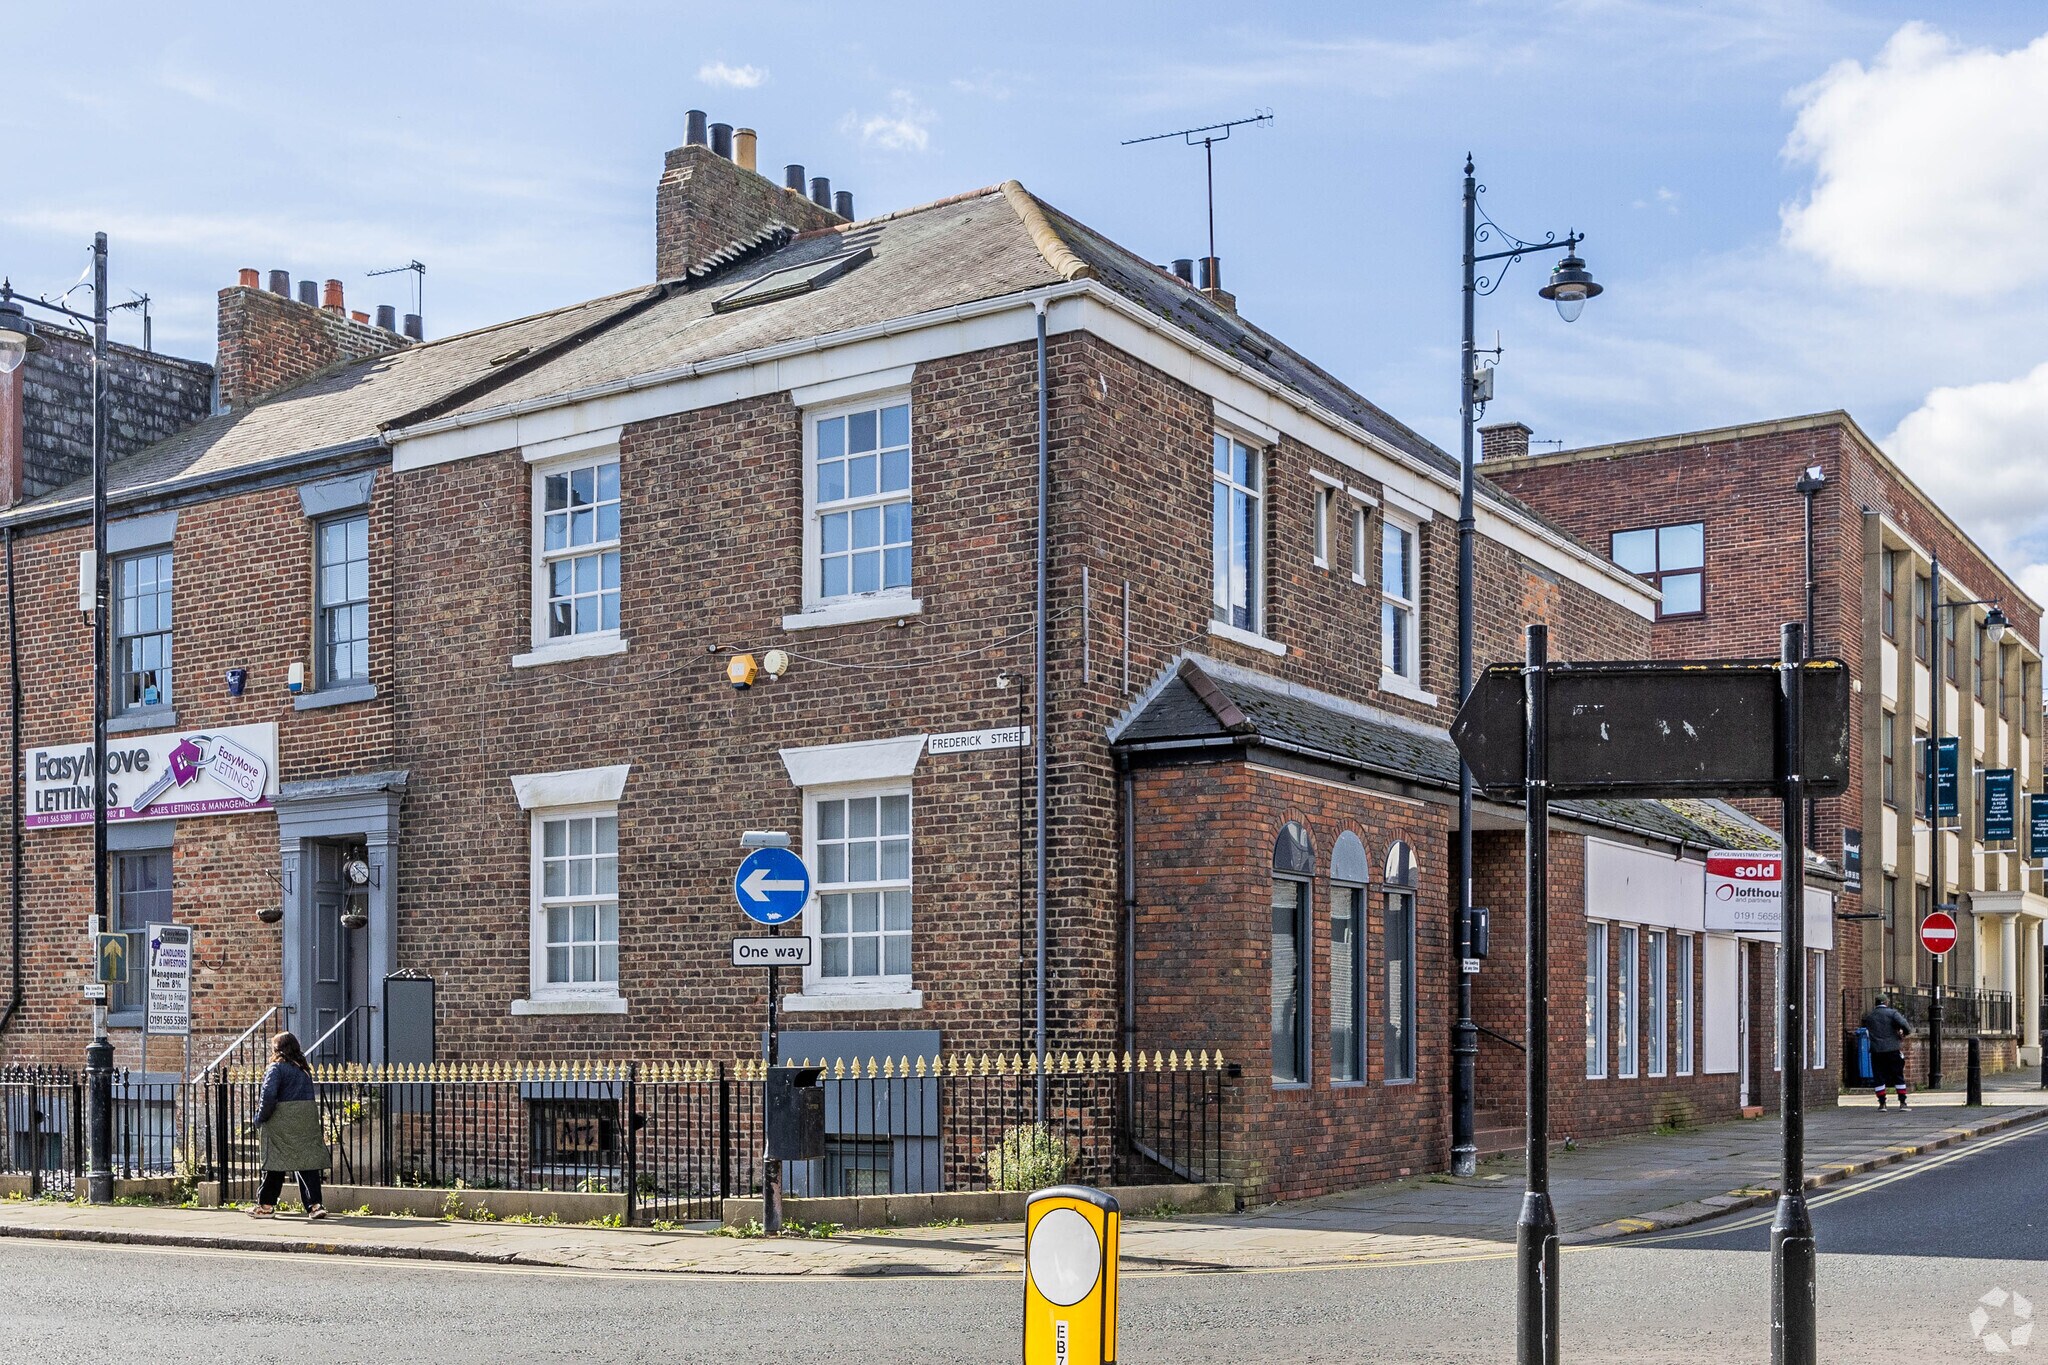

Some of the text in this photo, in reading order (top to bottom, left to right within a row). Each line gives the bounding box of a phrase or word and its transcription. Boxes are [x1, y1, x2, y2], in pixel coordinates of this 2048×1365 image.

[932, 731, 1026, 749] FREDERICK STREET
[218, 745, 259, 778] EasyMove
[213, 758, 255, 792] LETTINGS
[35, 783, 118, 808] LETTINS
[170, 802, 200, 813] LETTINGS
[202, 803, 207, 811] &
[37, 813, 49, 823] 0191
[50, 812, 59, 822] 565
[60, 811, 72, 821] 5389
[1734, 863, 1775, 878] sold
[1734, 911, 1755, 920] 0191
[160, 948, 187, 958] LANDLORDS
[739, 945, 804, 960] One way
[163, 959, 188, 968] INVESTORS
[151, 968, 186, 981] Management
[156, 979, 182, 989] From 8%
[150, 992, 167, 1003] Monday
[174, 993, 187, 1003] Friday
[149, 1015, 188, 1025] 0191 565 5389
